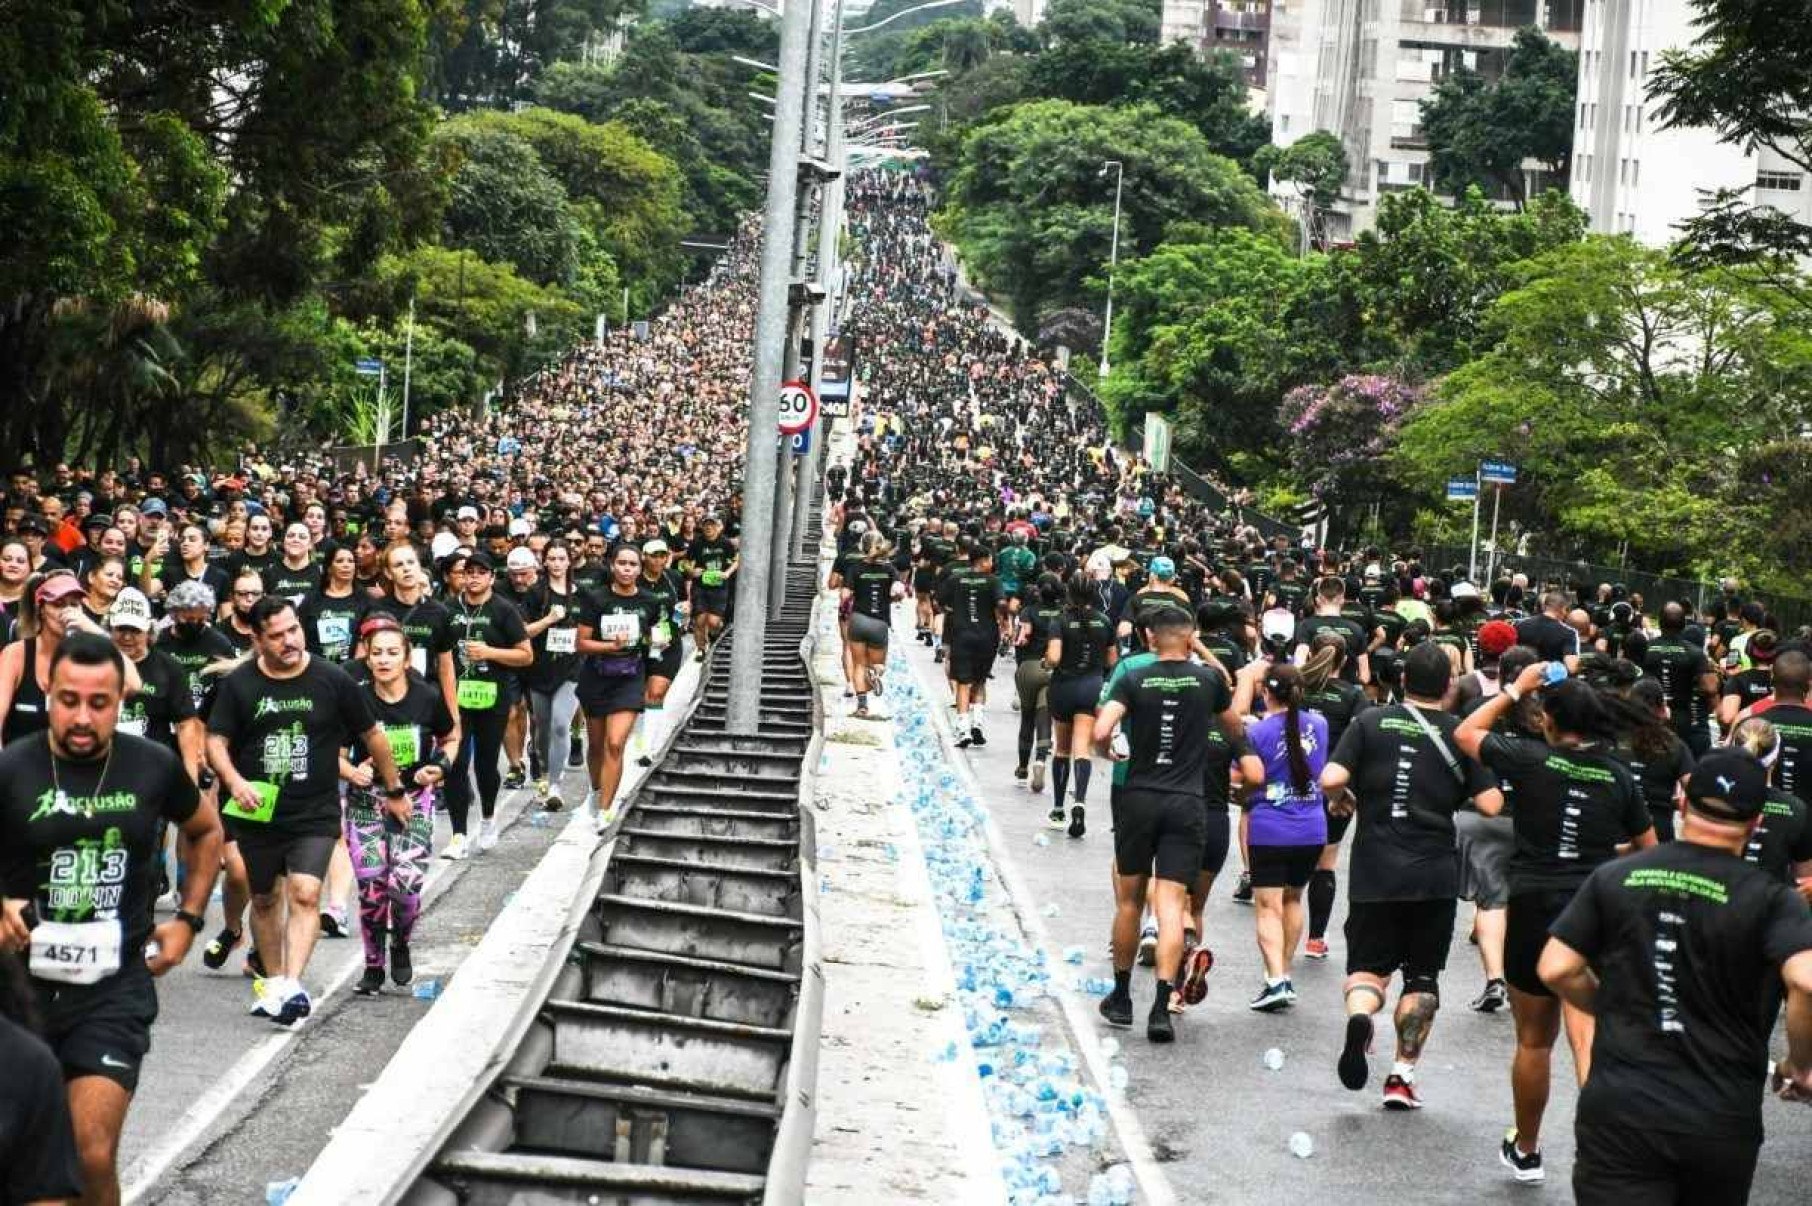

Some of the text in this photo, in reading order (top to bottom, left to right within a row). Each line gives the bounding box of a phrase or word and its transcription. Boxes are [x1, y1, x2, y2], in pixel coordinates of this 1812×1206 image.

[263, 735, 309, 757] 213
[50, 849, 128, 884] 213
[47, 885, 123, 908] DOWN
[45, 943, 98, 964] 4571
